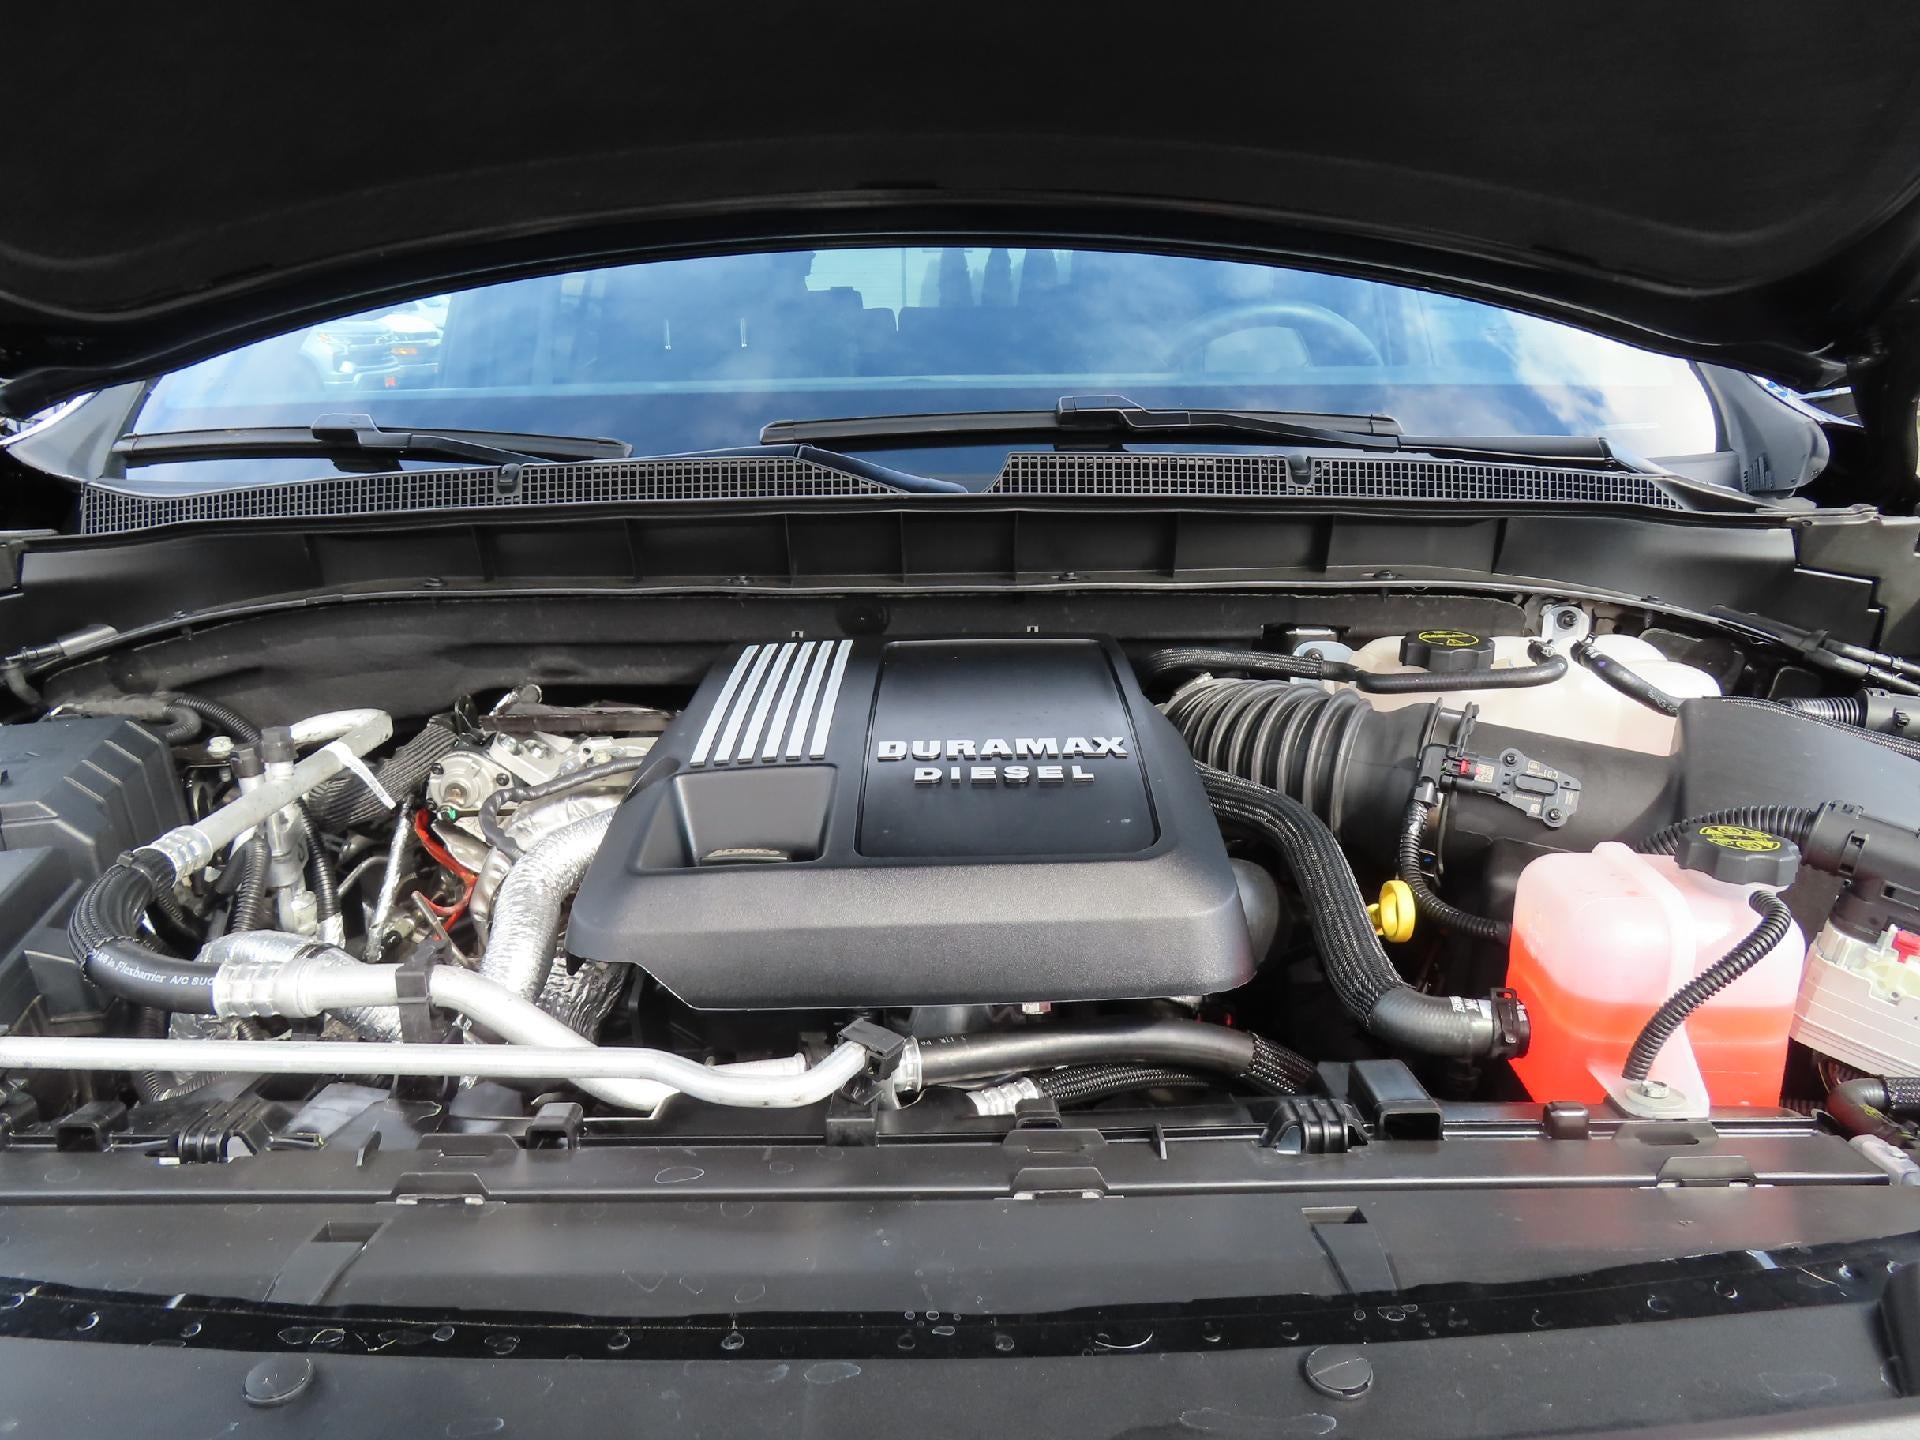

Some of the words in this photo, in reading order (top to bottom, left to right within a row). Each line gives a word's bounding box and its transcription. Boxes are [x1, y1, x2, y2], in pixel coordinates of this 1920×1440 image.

[877, 736, 1128, 760] DURAMAX
[913, 765, 1095, 784] DIESEL
[115, 961, 167, 983] Flexbarrier
[169, 975, 189, 985] A/C
